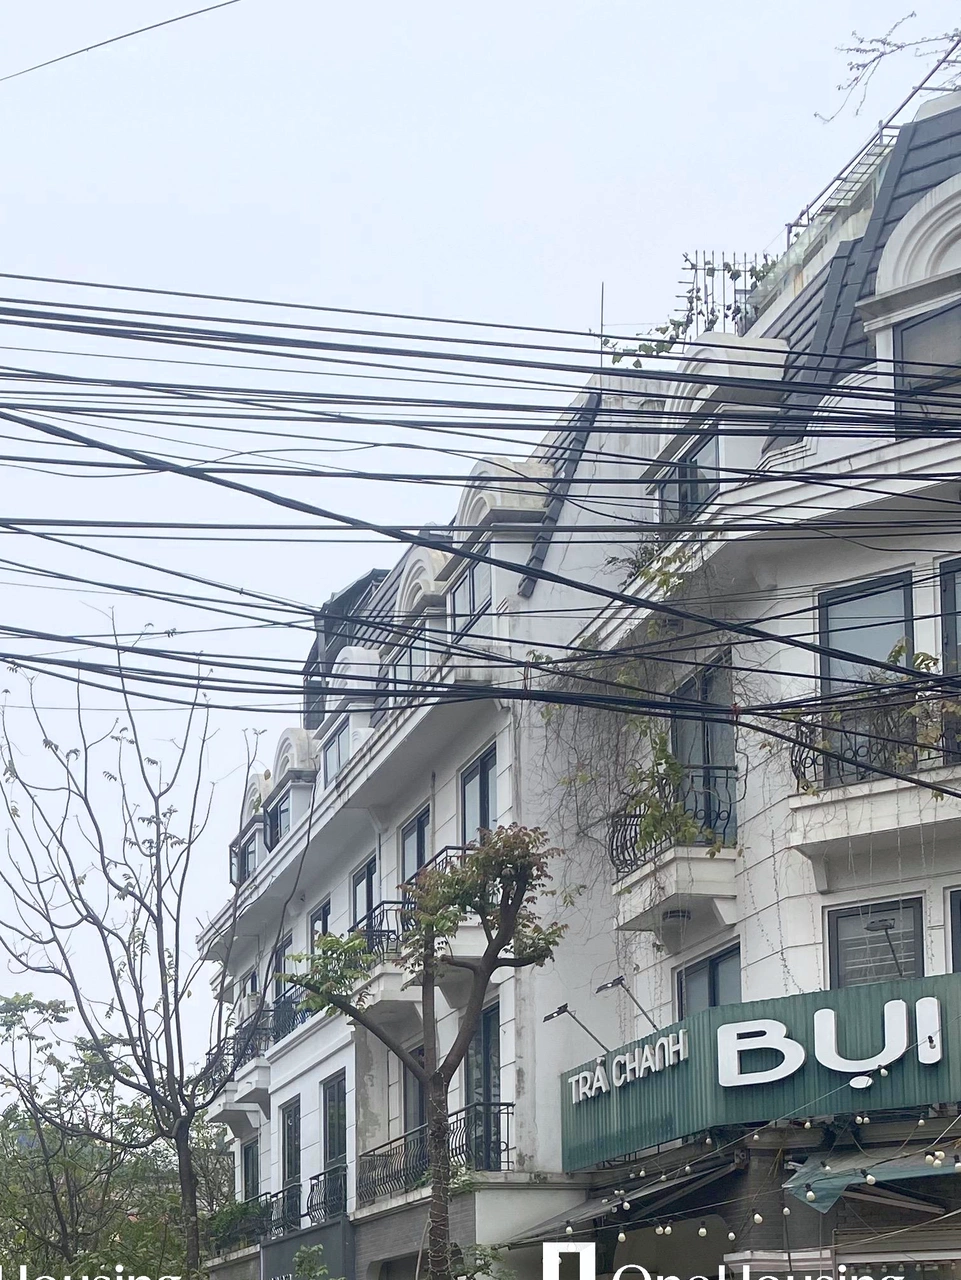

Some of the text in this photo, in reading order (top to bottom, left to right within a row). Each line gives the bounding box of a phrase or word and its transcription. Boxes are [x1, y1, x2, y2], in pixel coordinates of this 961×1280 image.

[568, 1029, 689, 1105] TRÀ CHANH
[717, 996, 942, 1089] BỤI
